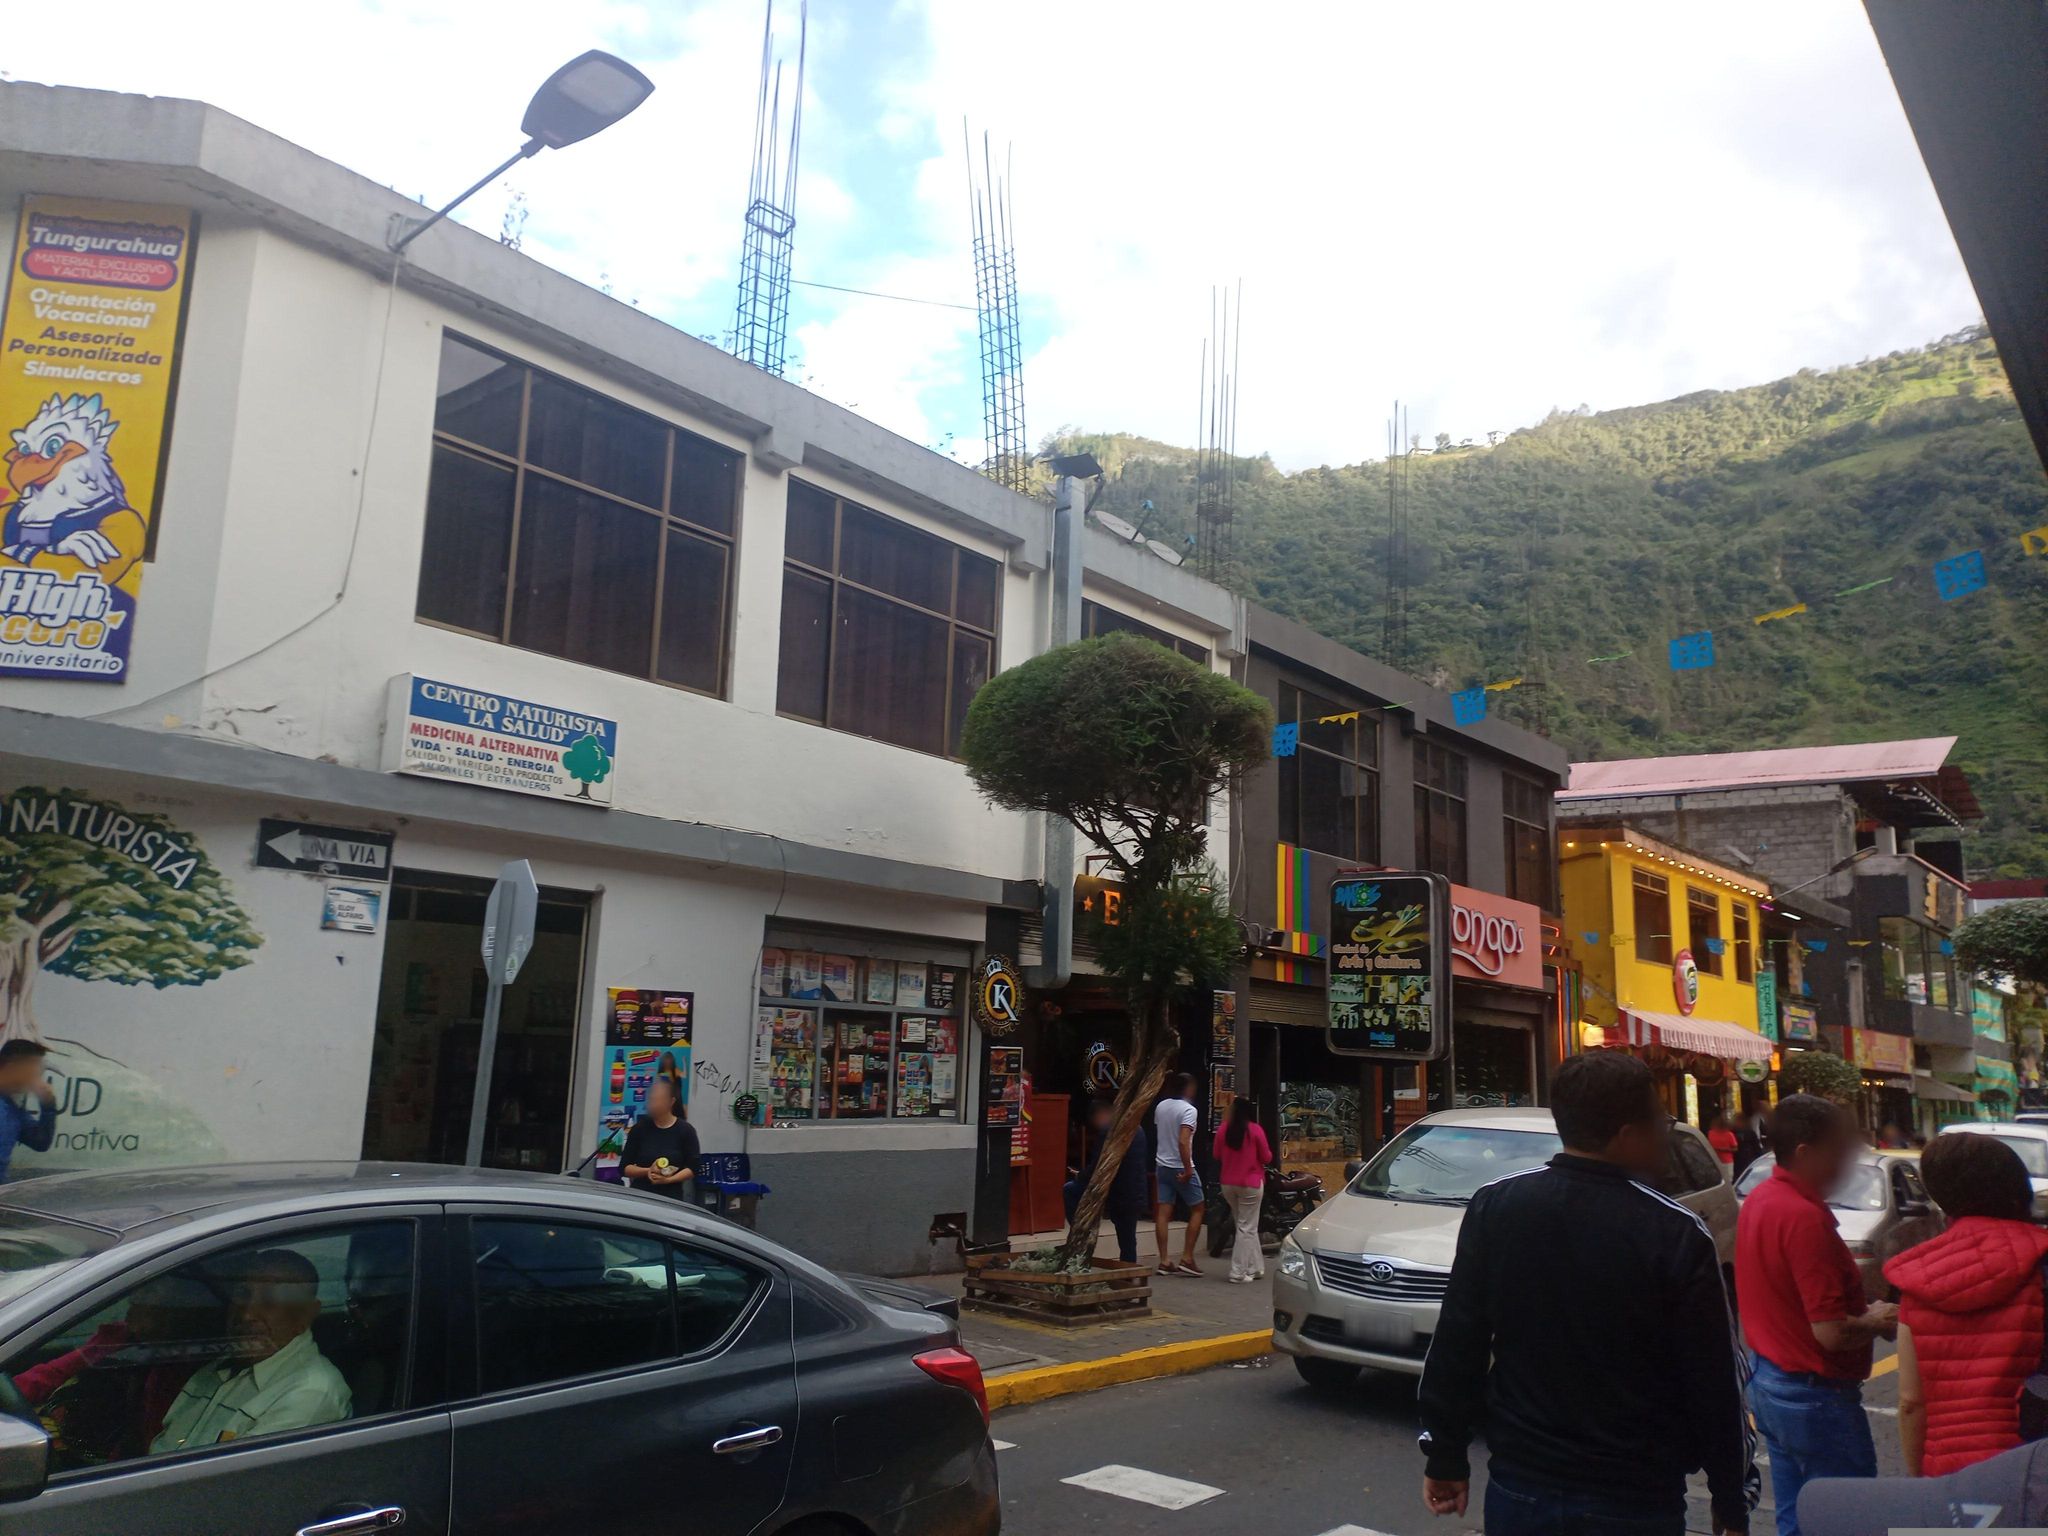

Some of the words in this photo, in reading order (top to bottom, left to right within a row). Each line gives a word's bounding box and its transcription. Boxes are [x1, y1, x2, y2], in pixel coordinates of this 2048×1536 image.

[33, 226, 178, 257] Tungurahua
[34, 253, 97, 269] MATERIAL
[98, 259, 167, 275] EXCLUSIVO
[62, 267, 150, 285] ACTUALIZADO
[29, 287, 157, 314] Orientación
[34, 303, 151, 329] Vocacional
[8, 338, 162, 366] Personalizada
[23, 360, 143, 385] Simulacros
[0, 570, 108, 628] High
[0, 614, 106, 649] core
[420, 682, 500, 714] CENTRO
[505, 701, 606, 737] NATURISTA
[409, 722, 475, 746] MEDICINA
[479, 736, 560, 763] ALTERNATIVA
[410, 738, 442, 753] VIDA
[455, 746, 494, 763] SALUD
[506, 757, 556, 775] ENERGIA
[404, 749, 446, 765] CALIDAD
[446, 756, 453, 767] Y
[456, 758, 501, 774] VARIEDAD
[502, 766, 515, 777] EN
[516, 769, 564, 785] PRODUCTOS
[419, 761, 475, 780] NACIONALES
[477, 770, 485, 781] Y
[486, 773, 552, 792] EXTRANJEROS
[9, 798, 198, 889] NATURISTA
[348, 844, 376, 865] VIA
[992, 984, 1019, 1023] K
